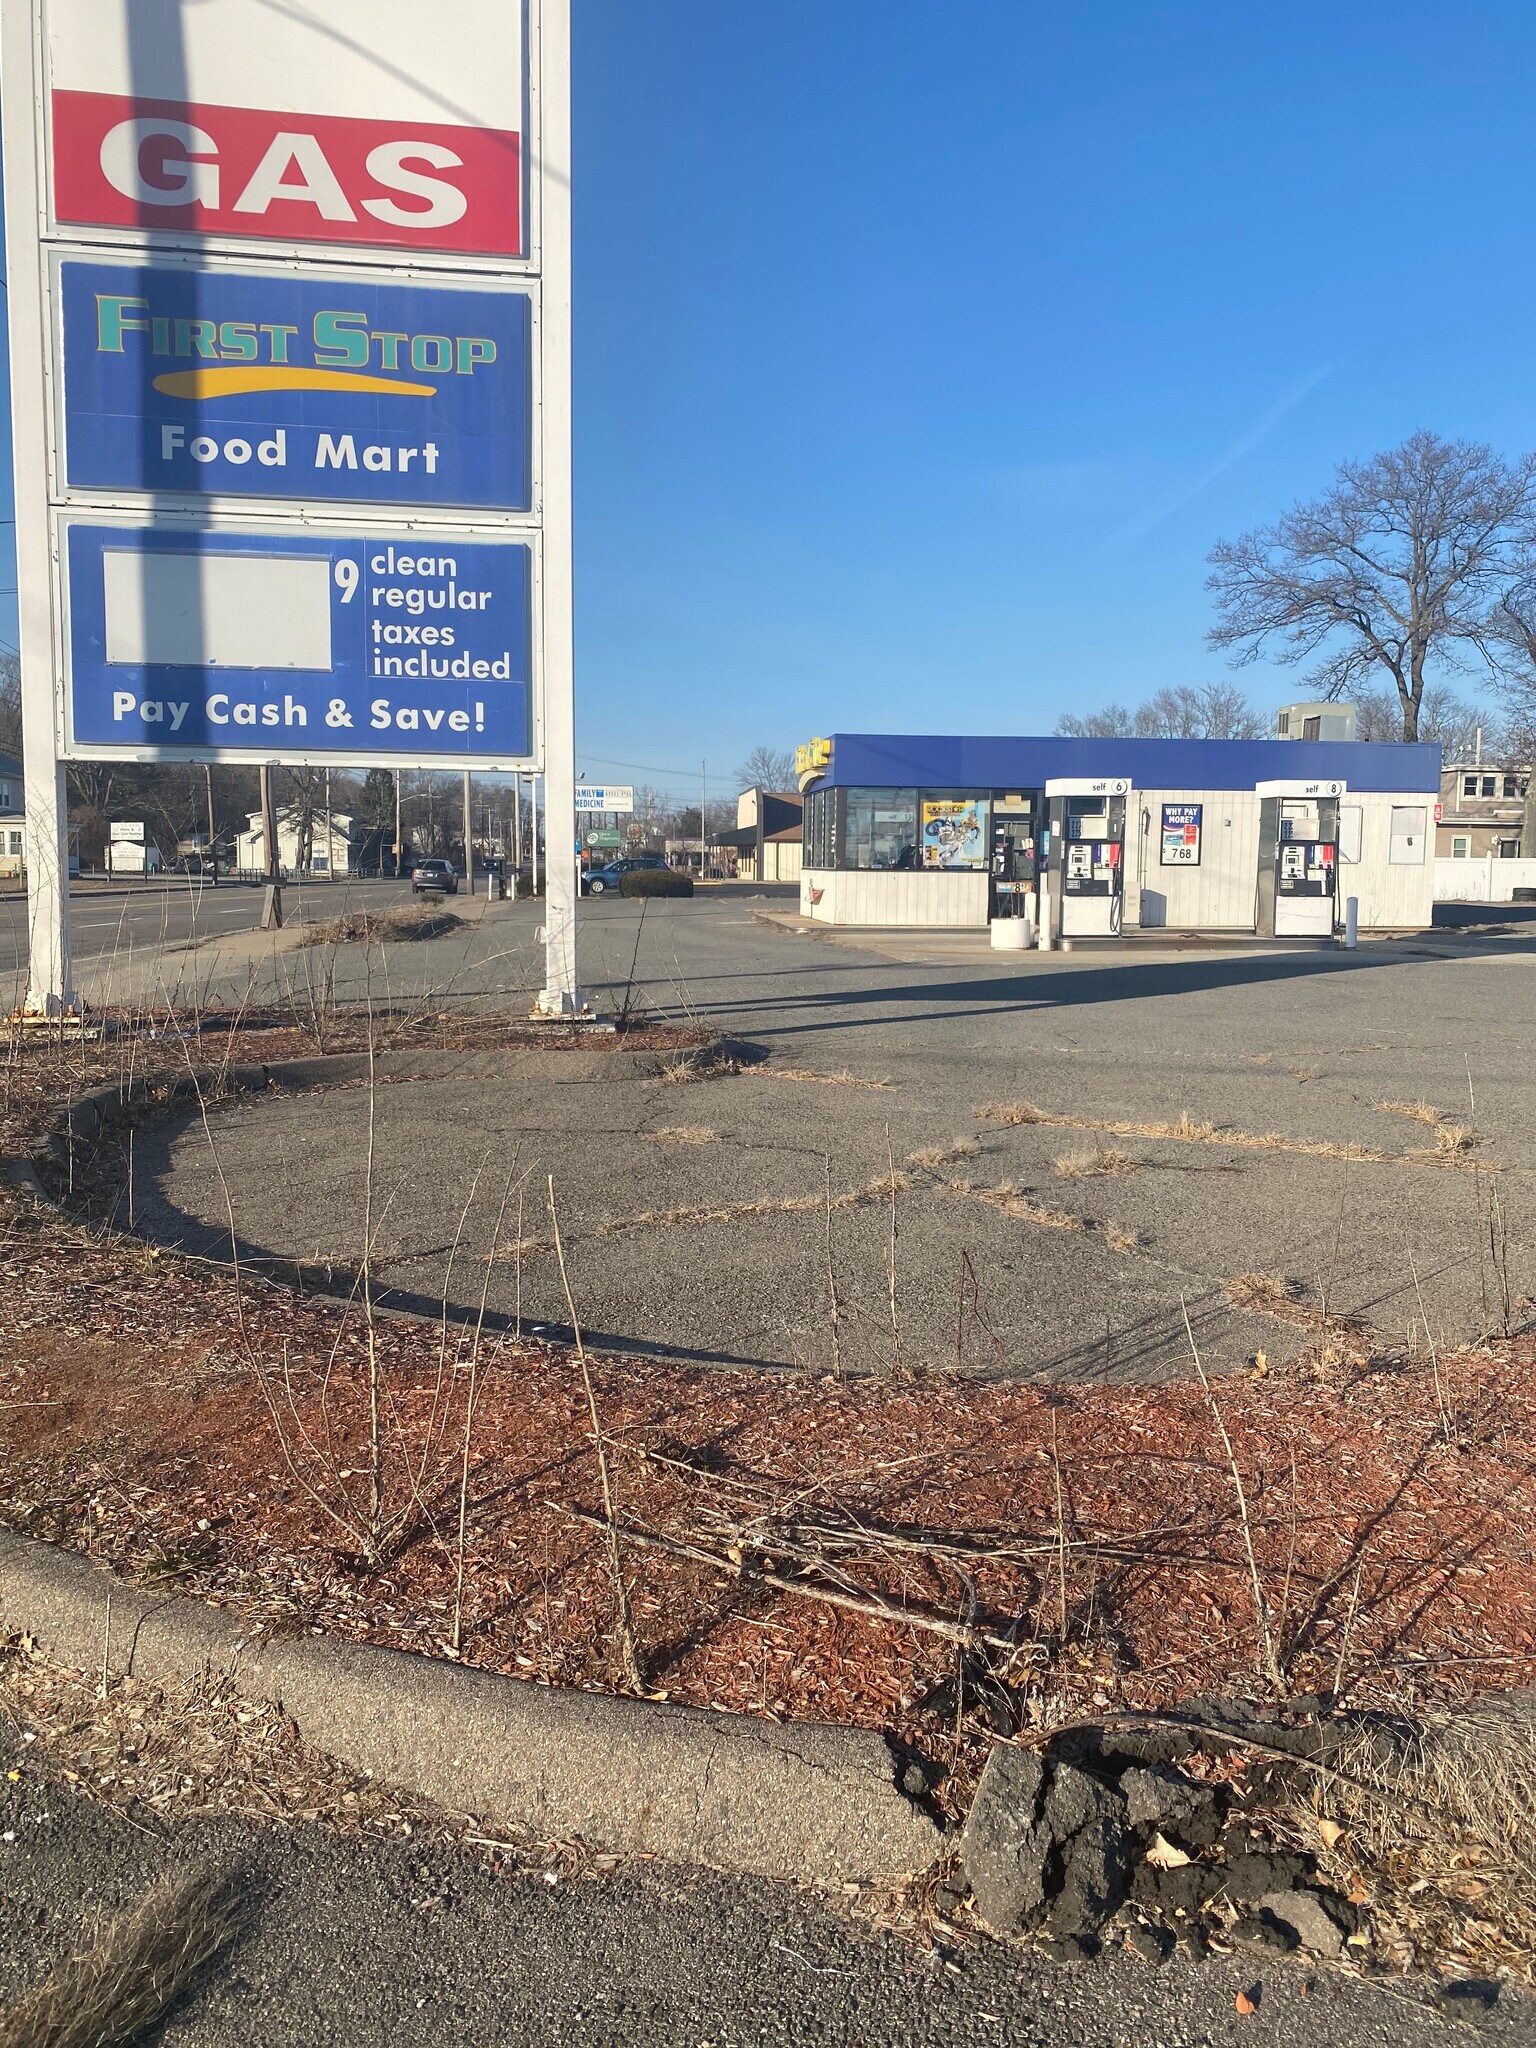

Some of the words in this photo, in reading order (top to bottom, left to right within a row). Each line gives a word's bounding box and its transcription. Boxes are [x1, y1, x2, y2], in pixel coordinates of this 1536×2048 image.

[100, 117, 467, 228] GAS
[95, 293, 298, 363] FIRST
[313, 310, 497, 375] STOP
[161, 425, 286, 466] Food
[314, 434, 439, 474] Mart
[371, 547, 457, 577] clean
[334, 559, 360, 604] 9
[371, 582, 492, 615] regular
[371, 620, 455, 646] taxes
[373, 648, 511, 680] included
[113, 692, 189, 731] Pay
[206, 694, 307, 727] Cash
[325, 699, 354, 728] &
[370, 699, 485, 732] Save!
[1092, 782, 1106, 791] self
[1116, 782, 1122, 791] 6
[1305, 785, 1319, 793] self
[1331, 784, 1337, 793] 8
